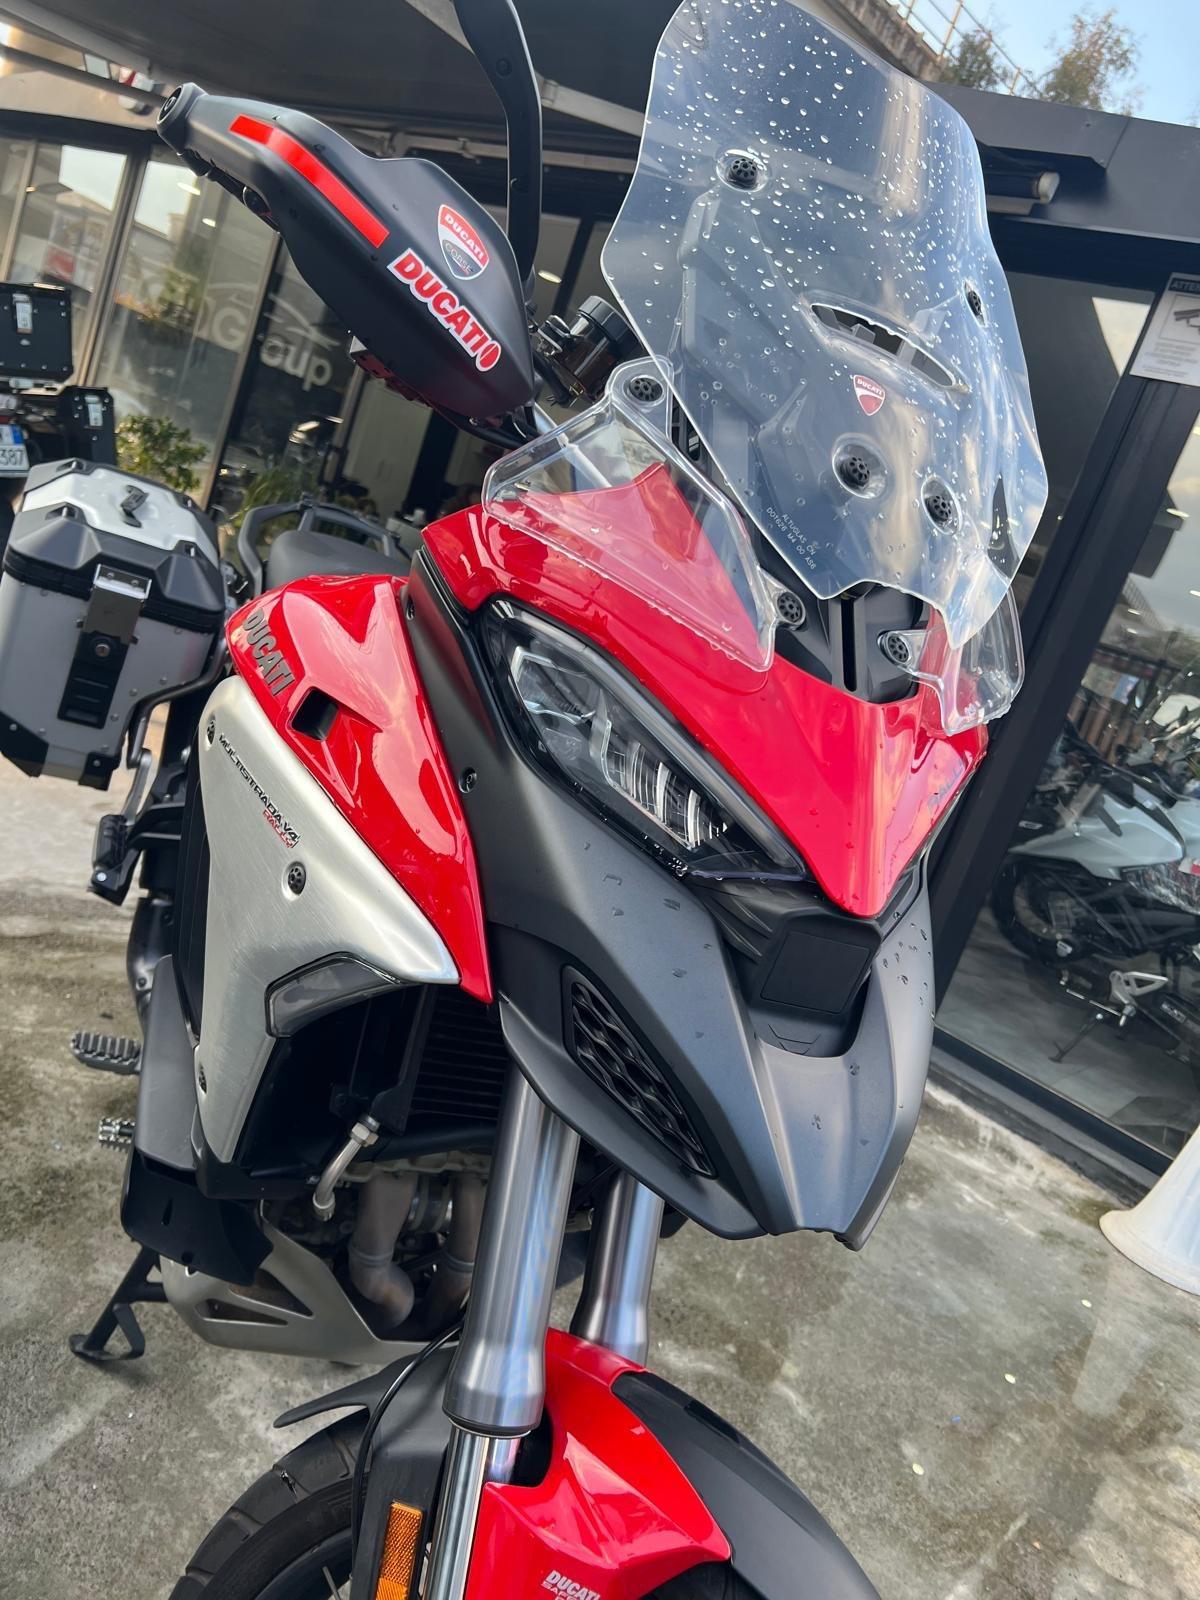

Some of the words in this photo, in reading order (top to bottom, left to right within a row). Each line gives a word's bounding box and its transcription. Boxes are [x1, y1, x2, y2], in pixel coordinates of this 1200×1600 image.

[444, 213, 484, 260] DUCATI
[445, 242, 473, 275] CORSE
[391, 251, 492, 355] DUCATI
[856, 378, 882, 395] DUCATI
[782, 513, 807, 544] ALTUGLAS
[787, 532, 797, 543] M4
[242, 607, 296, 697] DUCATI
